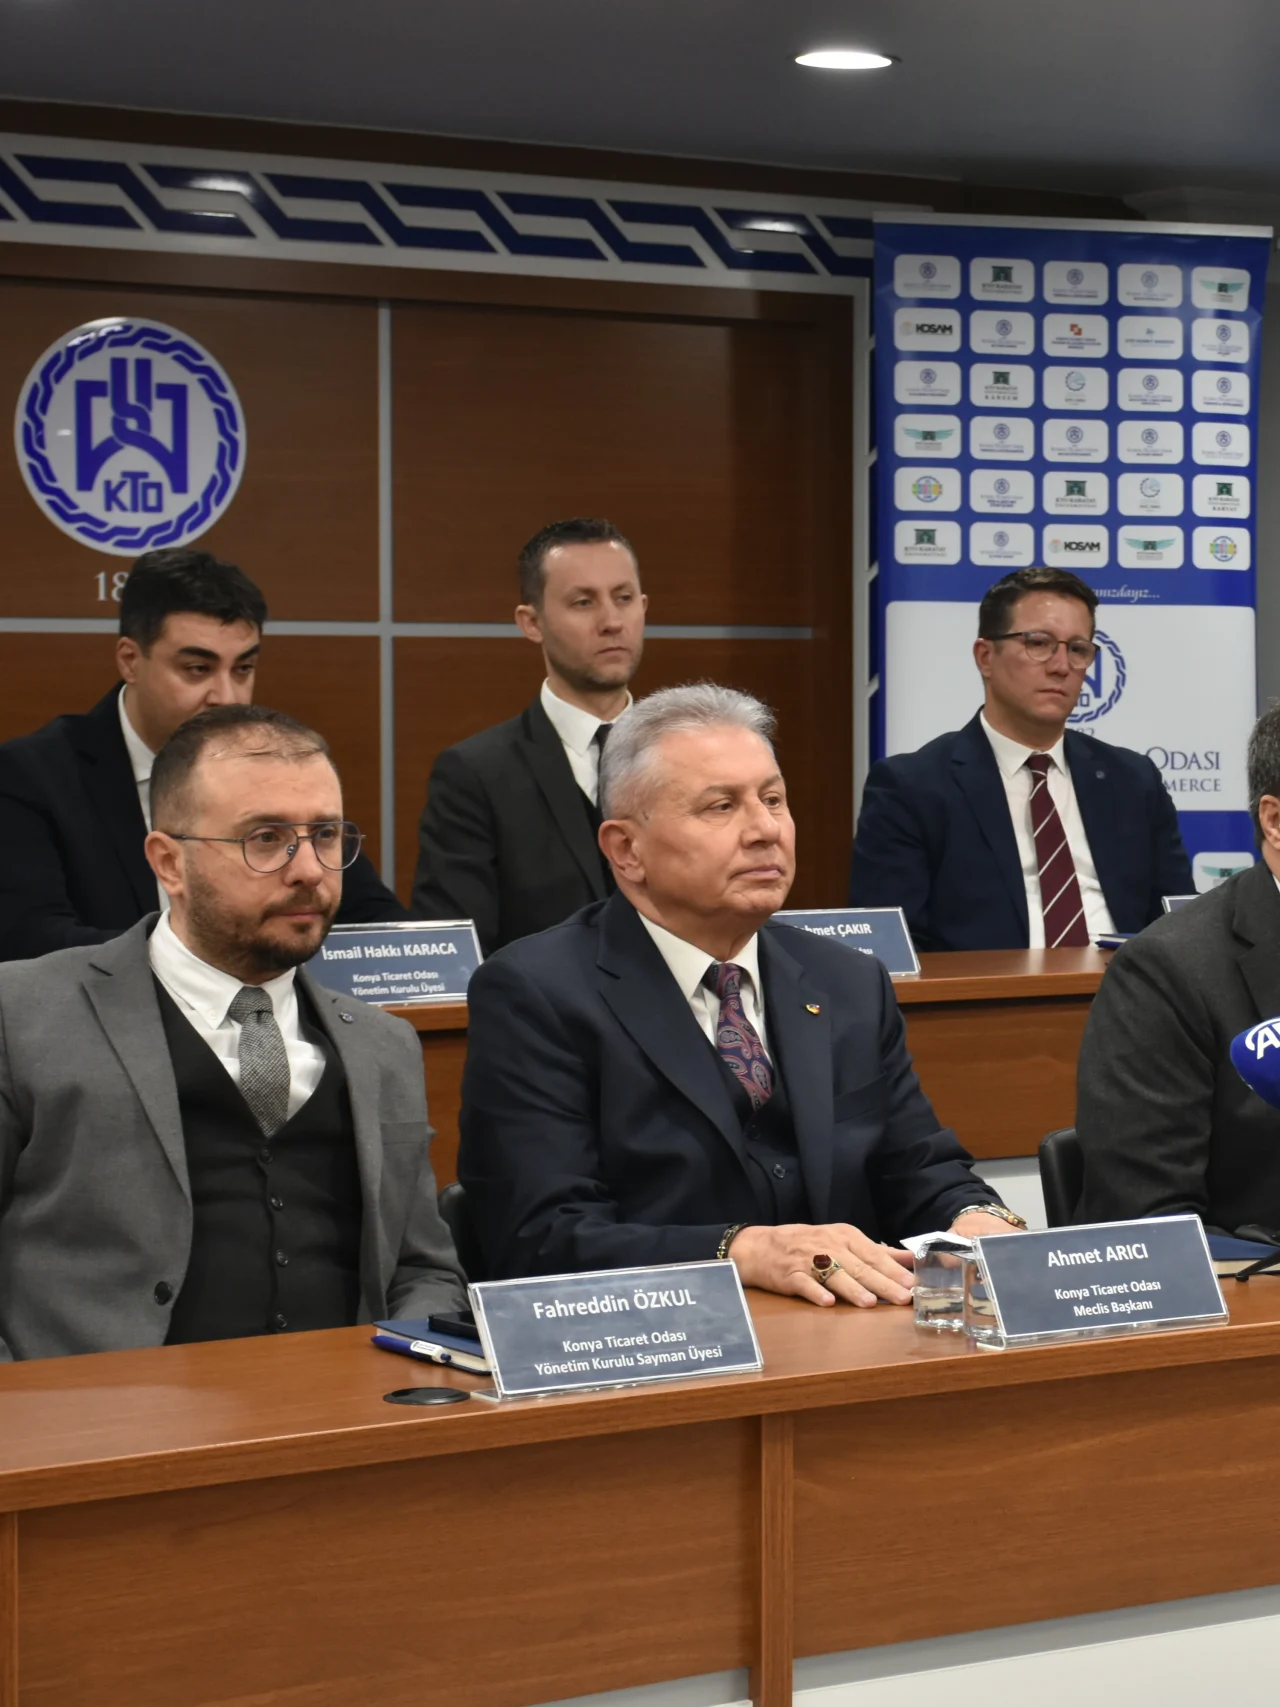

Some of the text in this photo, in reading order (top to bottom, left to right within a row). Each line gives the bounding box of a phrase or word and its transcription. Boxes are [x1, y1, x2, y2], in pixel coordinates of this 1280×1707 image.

[916, 323, 952, 334] KOSAM
[104, 471, 163, 513] KTO
[1064, 540, 1100, 552] KOSAM
[94, 572, 127, 601] 18
[1164, 778, 1221, 792] MERCE
[794, 923, 873, 937] hmet ÇAKIR
[321, 942, 458, 960] İsmail Hakkı KARACA
[352, 970, 438, 984] Konya Ticaret Odası
[352, 981, 446, 998] Yönetim Kurulu Üyesi
[1048, 1243, 1149, 1268] Ahmet ARICI
[1054, 1280, 1162, 1302] Konya Ticaret Odası
[533, 1288, 696, 1320] Fahreddin ÖZKUL
[1074, 1300, 1153, 1317] Meclis Başkanı
[562, 1330, 687, 1354] Konya Ticaret Odası
[534, 1346, 722, 1376] Yönetim Kurulu Sayman Üyesi
